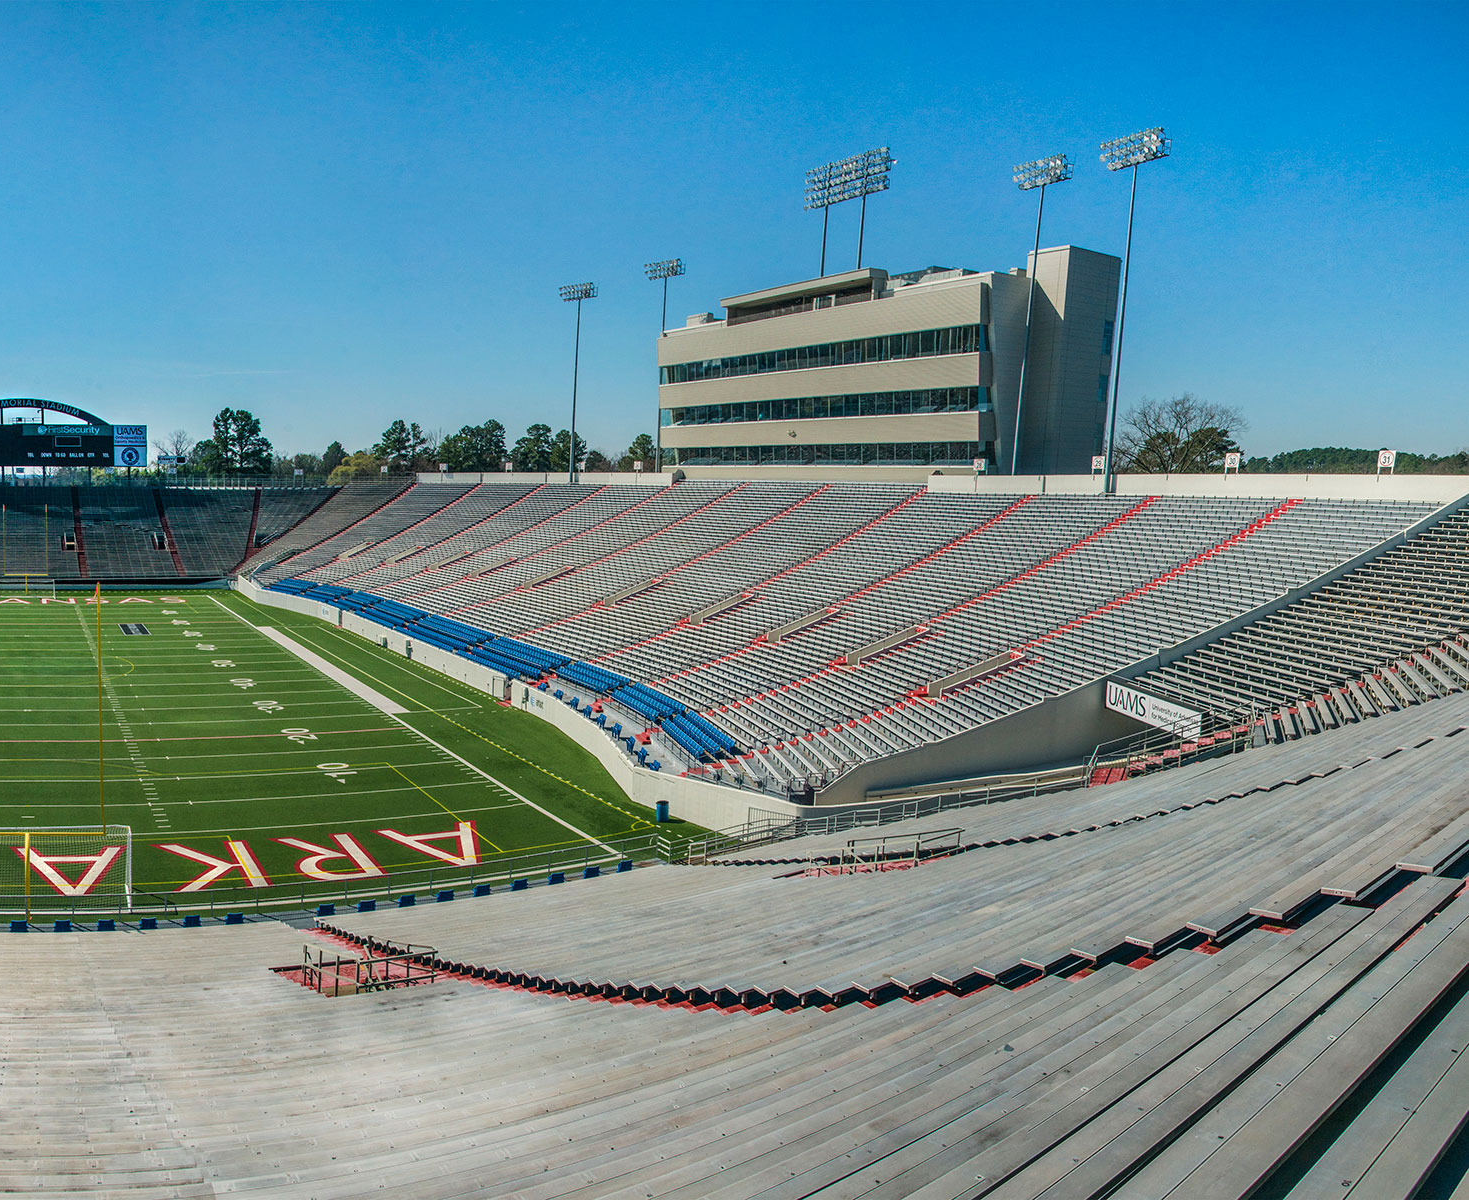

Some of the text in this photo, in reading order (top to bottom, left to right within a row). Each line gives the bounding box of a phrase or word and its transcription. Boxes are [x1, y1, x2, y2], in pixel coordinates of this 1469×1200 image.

[41, 400, 80, 416] STADIUM
[116, 427, 143, 435] UAMS
[1094, 459, 1102, 467] 29
[1228, 457, 1236, 465] 30
[1382, 455, 1390, 464] 31
[1109, 684, 1146, 717] UAMS
[252, 701, 284, 711] 30
[281, 728, 318, 741] 20
[316, 762, 358, 778] 10
